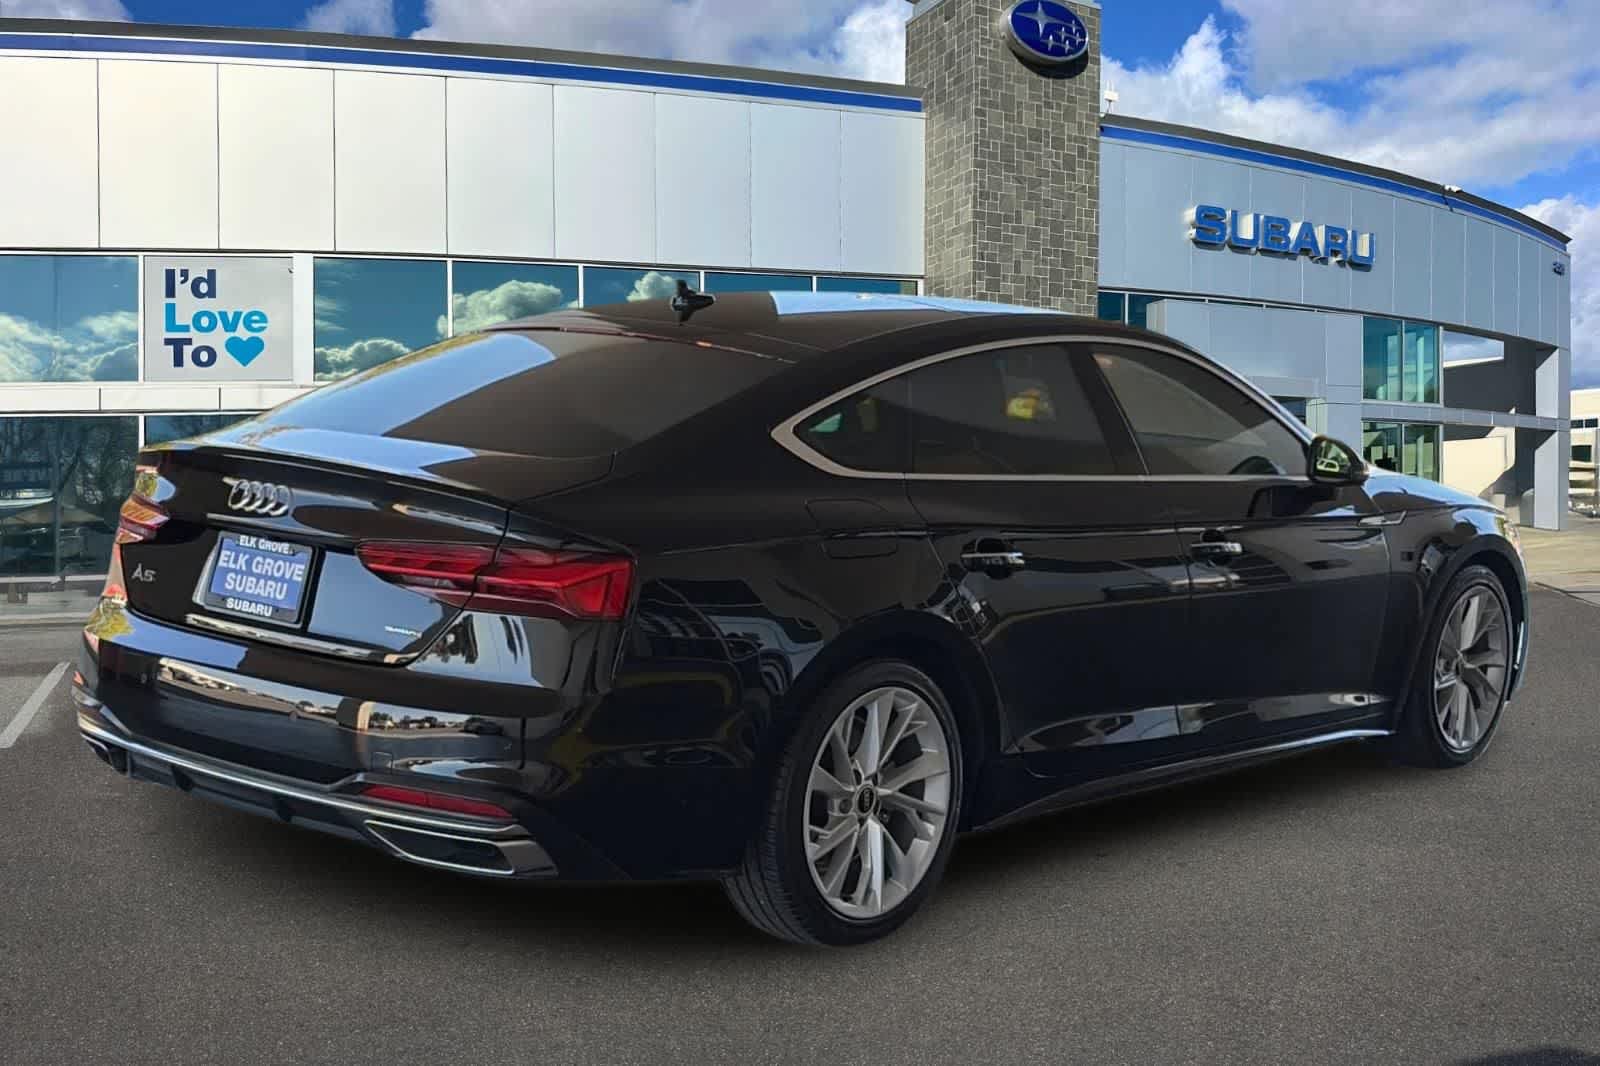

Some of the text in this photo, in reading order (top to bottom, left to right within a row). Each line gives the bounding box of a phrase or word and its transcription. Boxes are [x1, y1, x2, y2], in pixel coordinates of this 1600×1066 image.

[1193, 204, 1376, 266] SUBARU
[164, 268, 217, 299] I'd
[164, 302, 268, 333] Love
[163, 337, 217, 368] To
[239, 535, 290, 554] ELK GROVE
[218, 550, 305, 581] ELK GROVE
[224, 572, 288, 600] SUBARU
[226, 597, 273, 617] SUBARU
